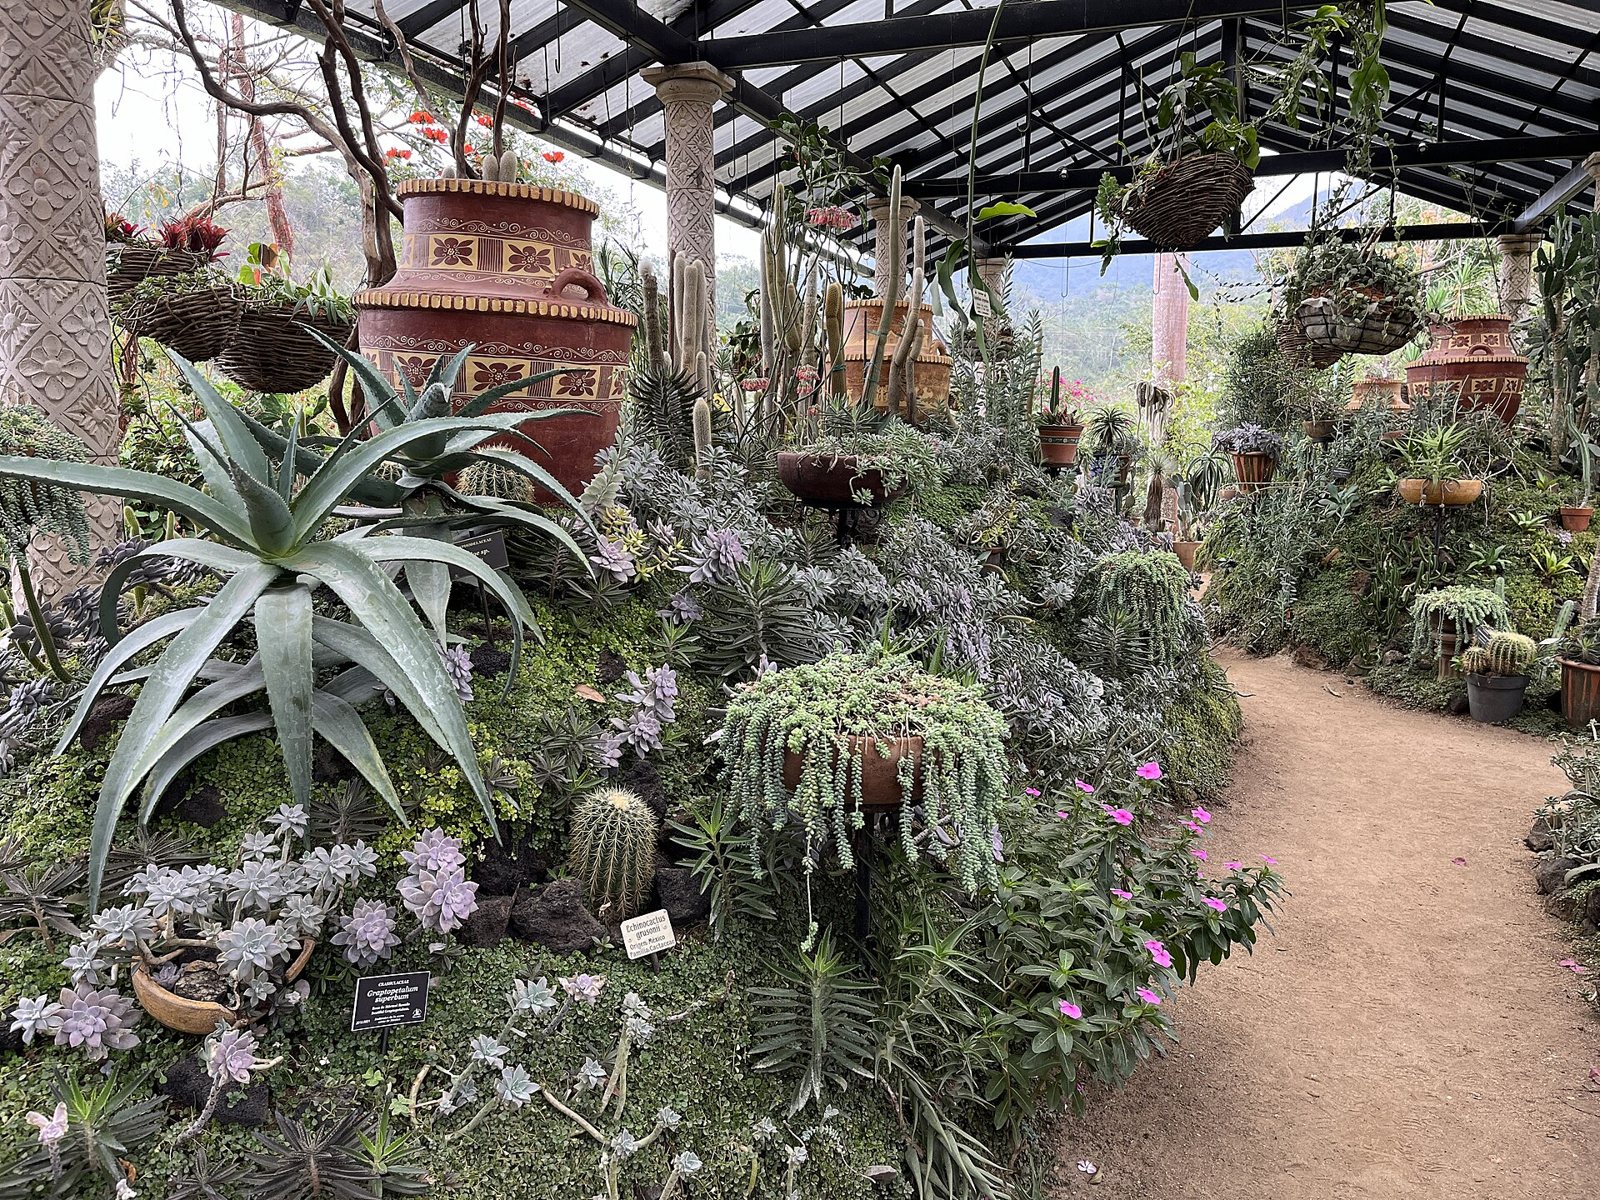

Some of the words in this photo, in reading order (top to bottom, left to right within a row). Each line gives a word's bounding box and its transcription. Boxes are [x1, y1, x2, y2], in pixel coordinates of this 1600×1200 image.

[626, 915, 666, 933] Echinocactus
[636, 926, 660, 940] grusonii
[367, 985, 419, 998] Graptopetalum
[374, 994, 409, 1003] superbum
